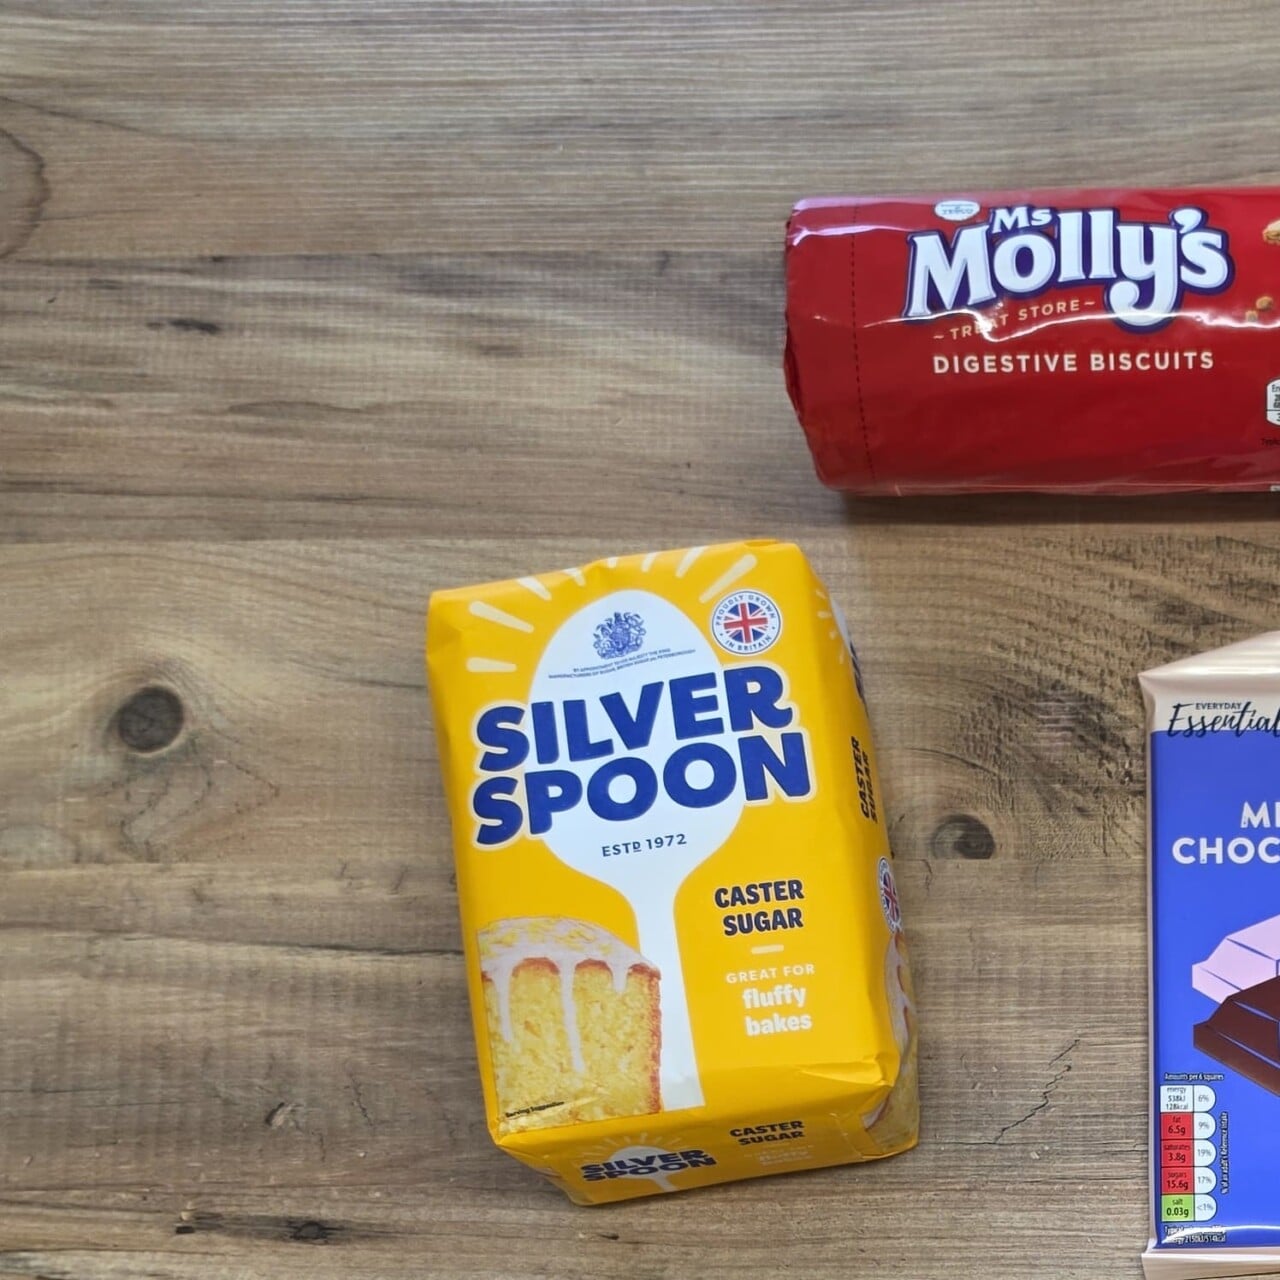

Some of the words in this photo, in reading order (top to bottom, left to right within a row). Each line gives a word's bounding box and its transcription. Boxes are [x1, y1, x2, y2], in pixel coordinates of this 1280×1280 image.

[990, 205, 1054, 234] Ms
[903, 206, 1232, 330] Molly's
[1018, 298, 1081, 321] STORE
[933, 353, 1077, 374] DIGESTIVE
[1090, 350, 1215, 372] BISCUITS
[737, 635, 772, 650] BRITAIN
[1195, 702, 1242, 710] EVERYDAY
[476, 665, 794, 772] SILVER
[850, 735, 870, 819] CASTER
[473, 731, 812, 846] SPOON
[645, 832, 688, 852] 1972
[714, 879, 805, 909] CASTER
[722, 907, 805, 937] SUGAR
[726, 966, 781, 985] GREAT
[783, 963, 816, 978] FOR
[742, 983, 807, 1011] fluffy
[745, 1012, 813, 1037] bakes
[729, 1120, 805, 1138] CASTER
[1172, 1116, 1181, 1124] fat
[1198, 1121, 1210, 1130] 9%
[738, 1130, 805, 1146] SUGAR
[1168, 1125, 1186, 1136] 6.5g
[580, 1149, 710, 1171] SILVER
[1168, 1153, 1186, 1164] 3.8g
[1197, 1149, 1212, 1157] 19%
[582, 1156, 718, 1182] SPOON
[1168, 1171, 1187, 1180] sugars
[1166, 1180, 1189, 1191] 15.6g
[1197, 1176, 1213, 1185] 17%
[1172, 1198, 1184, 1206] salt
[1196, 1202, 1214, 1212] <1%
[1166, 1207, 1189, 1218] 0.03g
